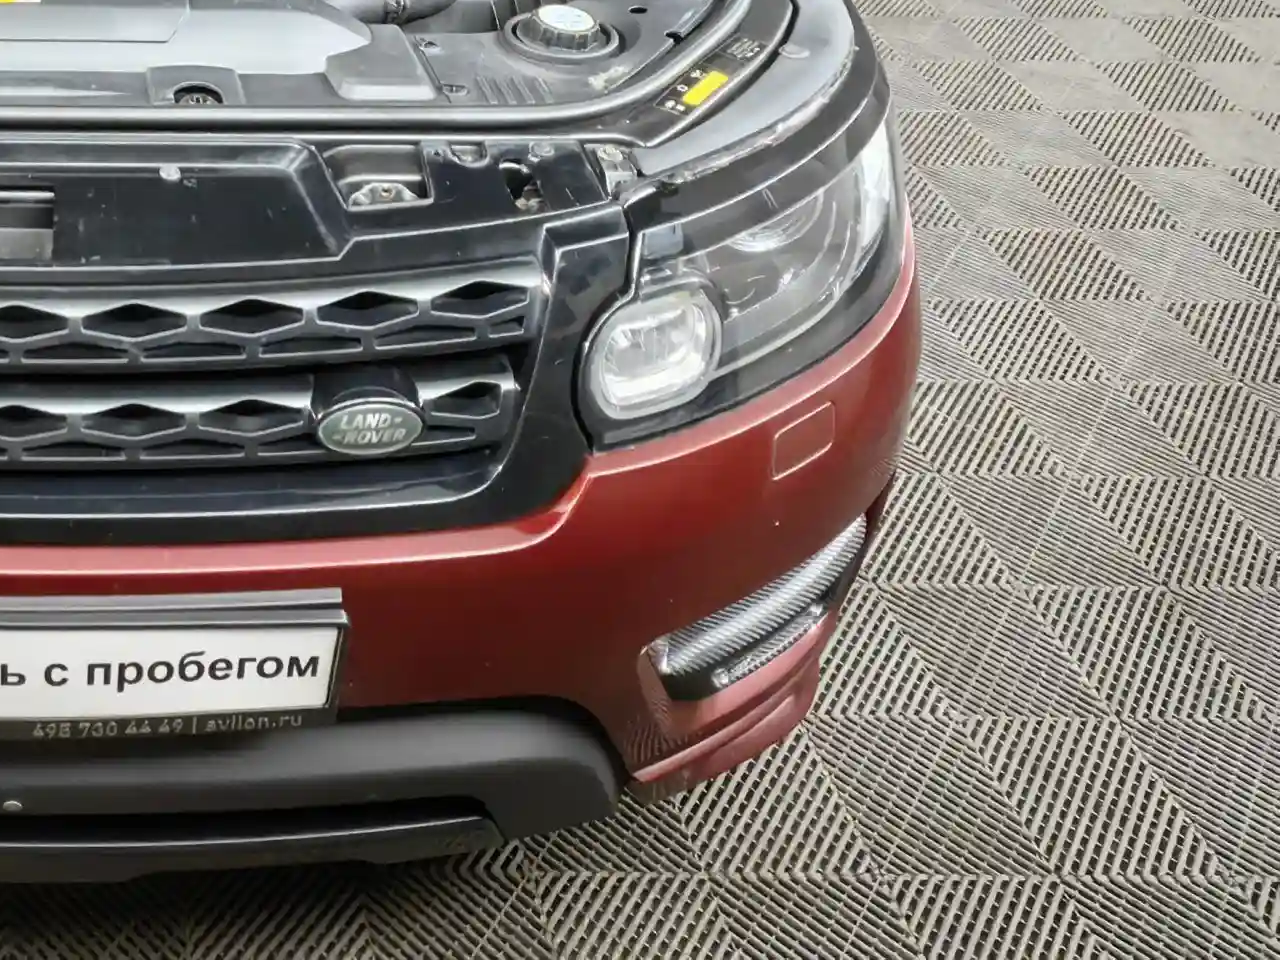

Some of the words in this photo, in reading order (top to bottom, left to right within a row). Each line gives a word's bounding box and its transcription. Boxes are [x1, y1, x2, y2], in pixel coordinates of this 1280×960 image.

[44, 663, 69, 687] с
[86, 650, 320, 693] пробегом
[78, 721, 118, 738] 730
[124, 720, 152, 735] 44
[158, 717, 184, 734] 49
